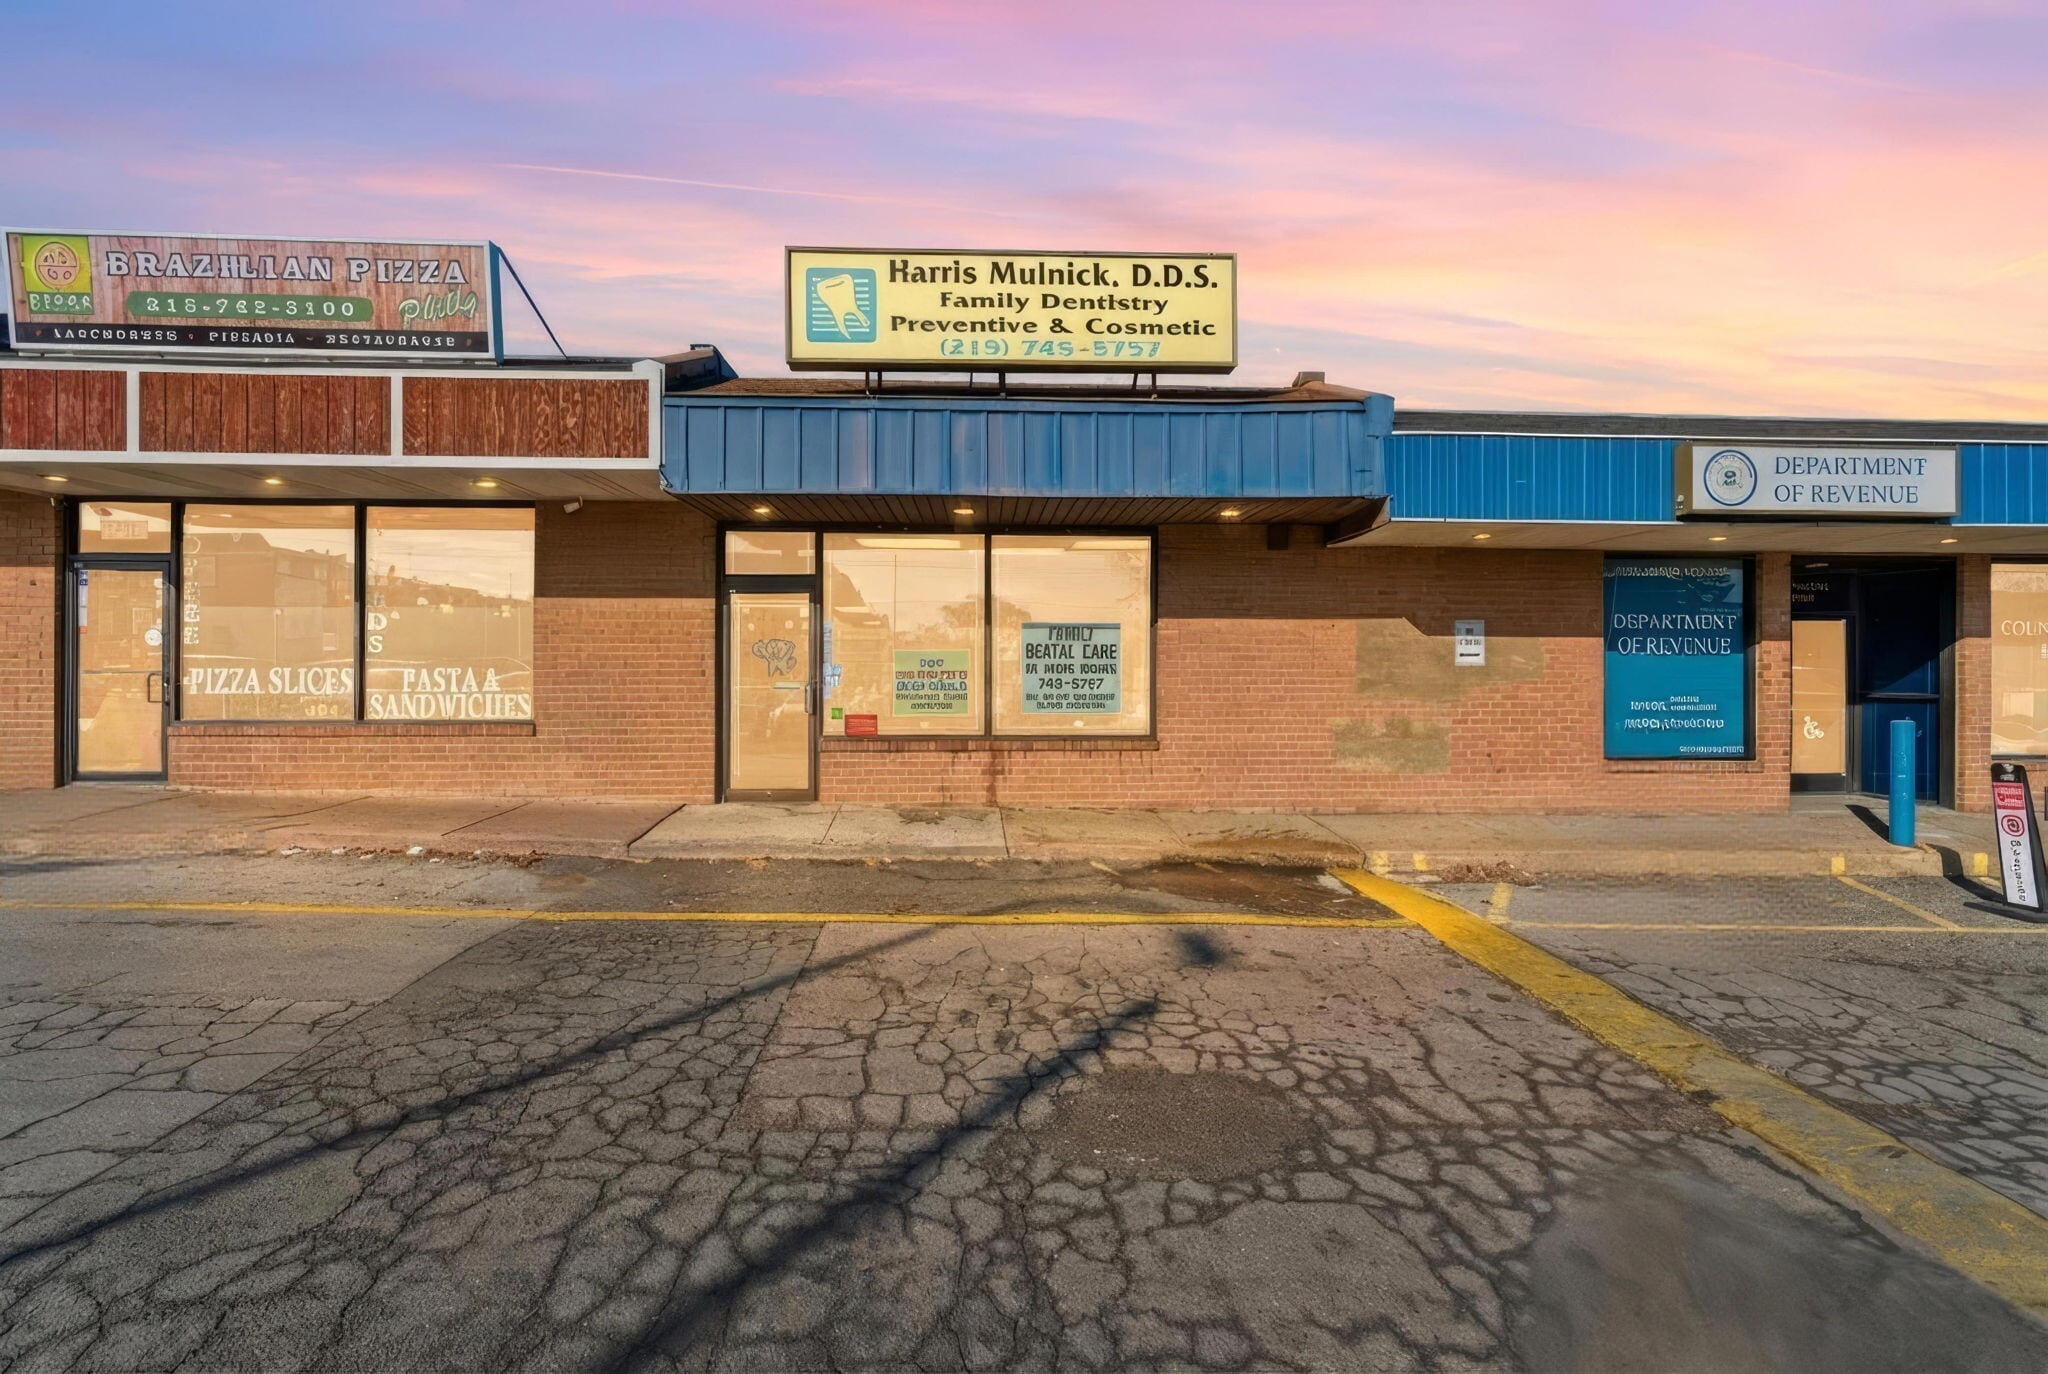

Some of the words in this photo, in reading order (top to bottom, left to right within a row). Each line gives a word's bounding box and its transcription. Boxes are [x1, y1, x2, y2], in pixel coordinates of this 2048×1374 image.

[346, 257, 469, 285] PIZZA
[889, 260, 977, 284] Harris
[1132, 264, 1218, 288] D.D.S.
[941, 292, 1030, 313] Family
[891, 316, 1038, 333] Preventive
[1050, 318, 1073, 334] &
[1085, 318, 1217, 336] Cosmetic
[1774, 485, 1804, 502] OF
[1811, 485, 1919, 503] REVENUE
[187, 667, 265, 695] PIZZA
[268, 667, 355, 695] SLICES
